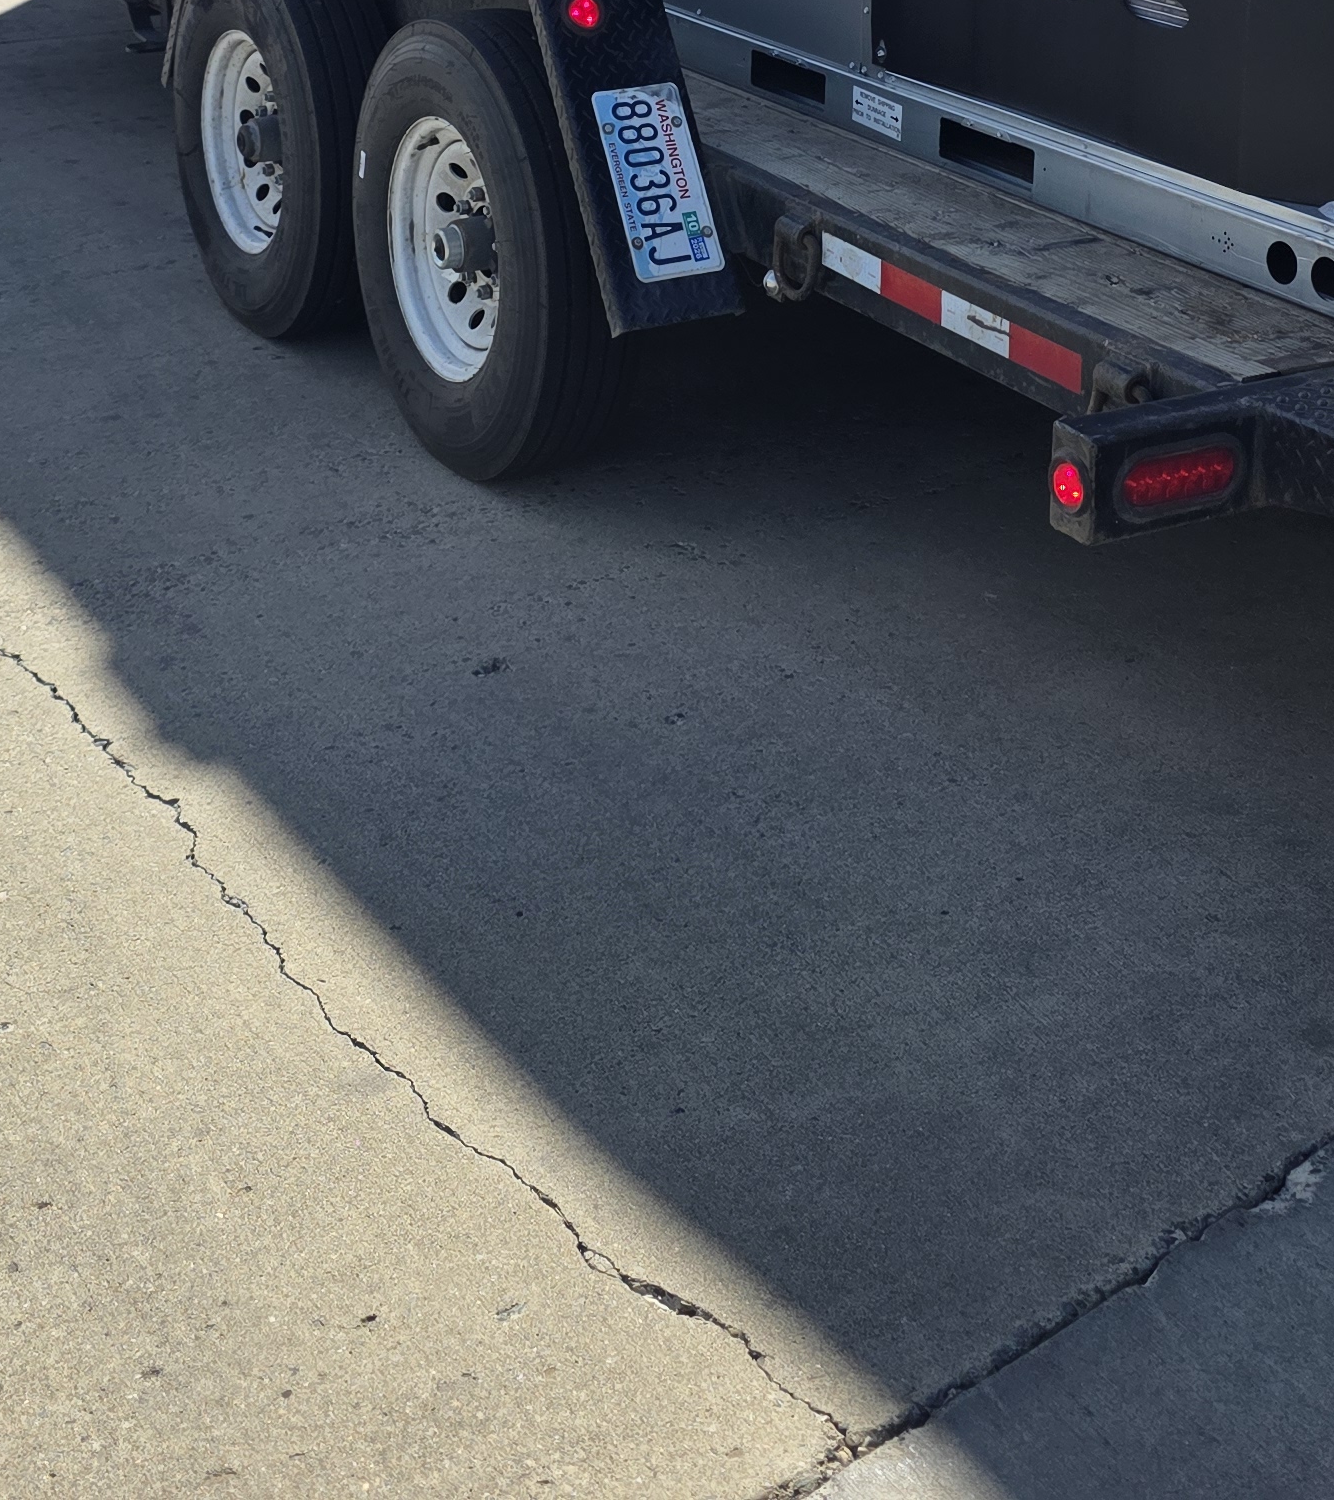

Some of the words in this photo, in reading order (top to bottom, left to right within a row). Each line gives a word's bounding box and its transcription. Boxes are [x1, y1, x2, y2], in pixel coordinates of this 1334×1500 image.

[655, 99, 691, 199] WASHINGTON
[866, 113, 872, 121] TO
[873, 117, 901, 134] INSTALLATION
[608, 142, 628, 198] EVERGREEN
[623, 202, 637, 232] STATE
[611, 99, 692, 266] 88036AJ
[685, 214, 699, 231] 10
[690, 238, 703, 260] 2026
